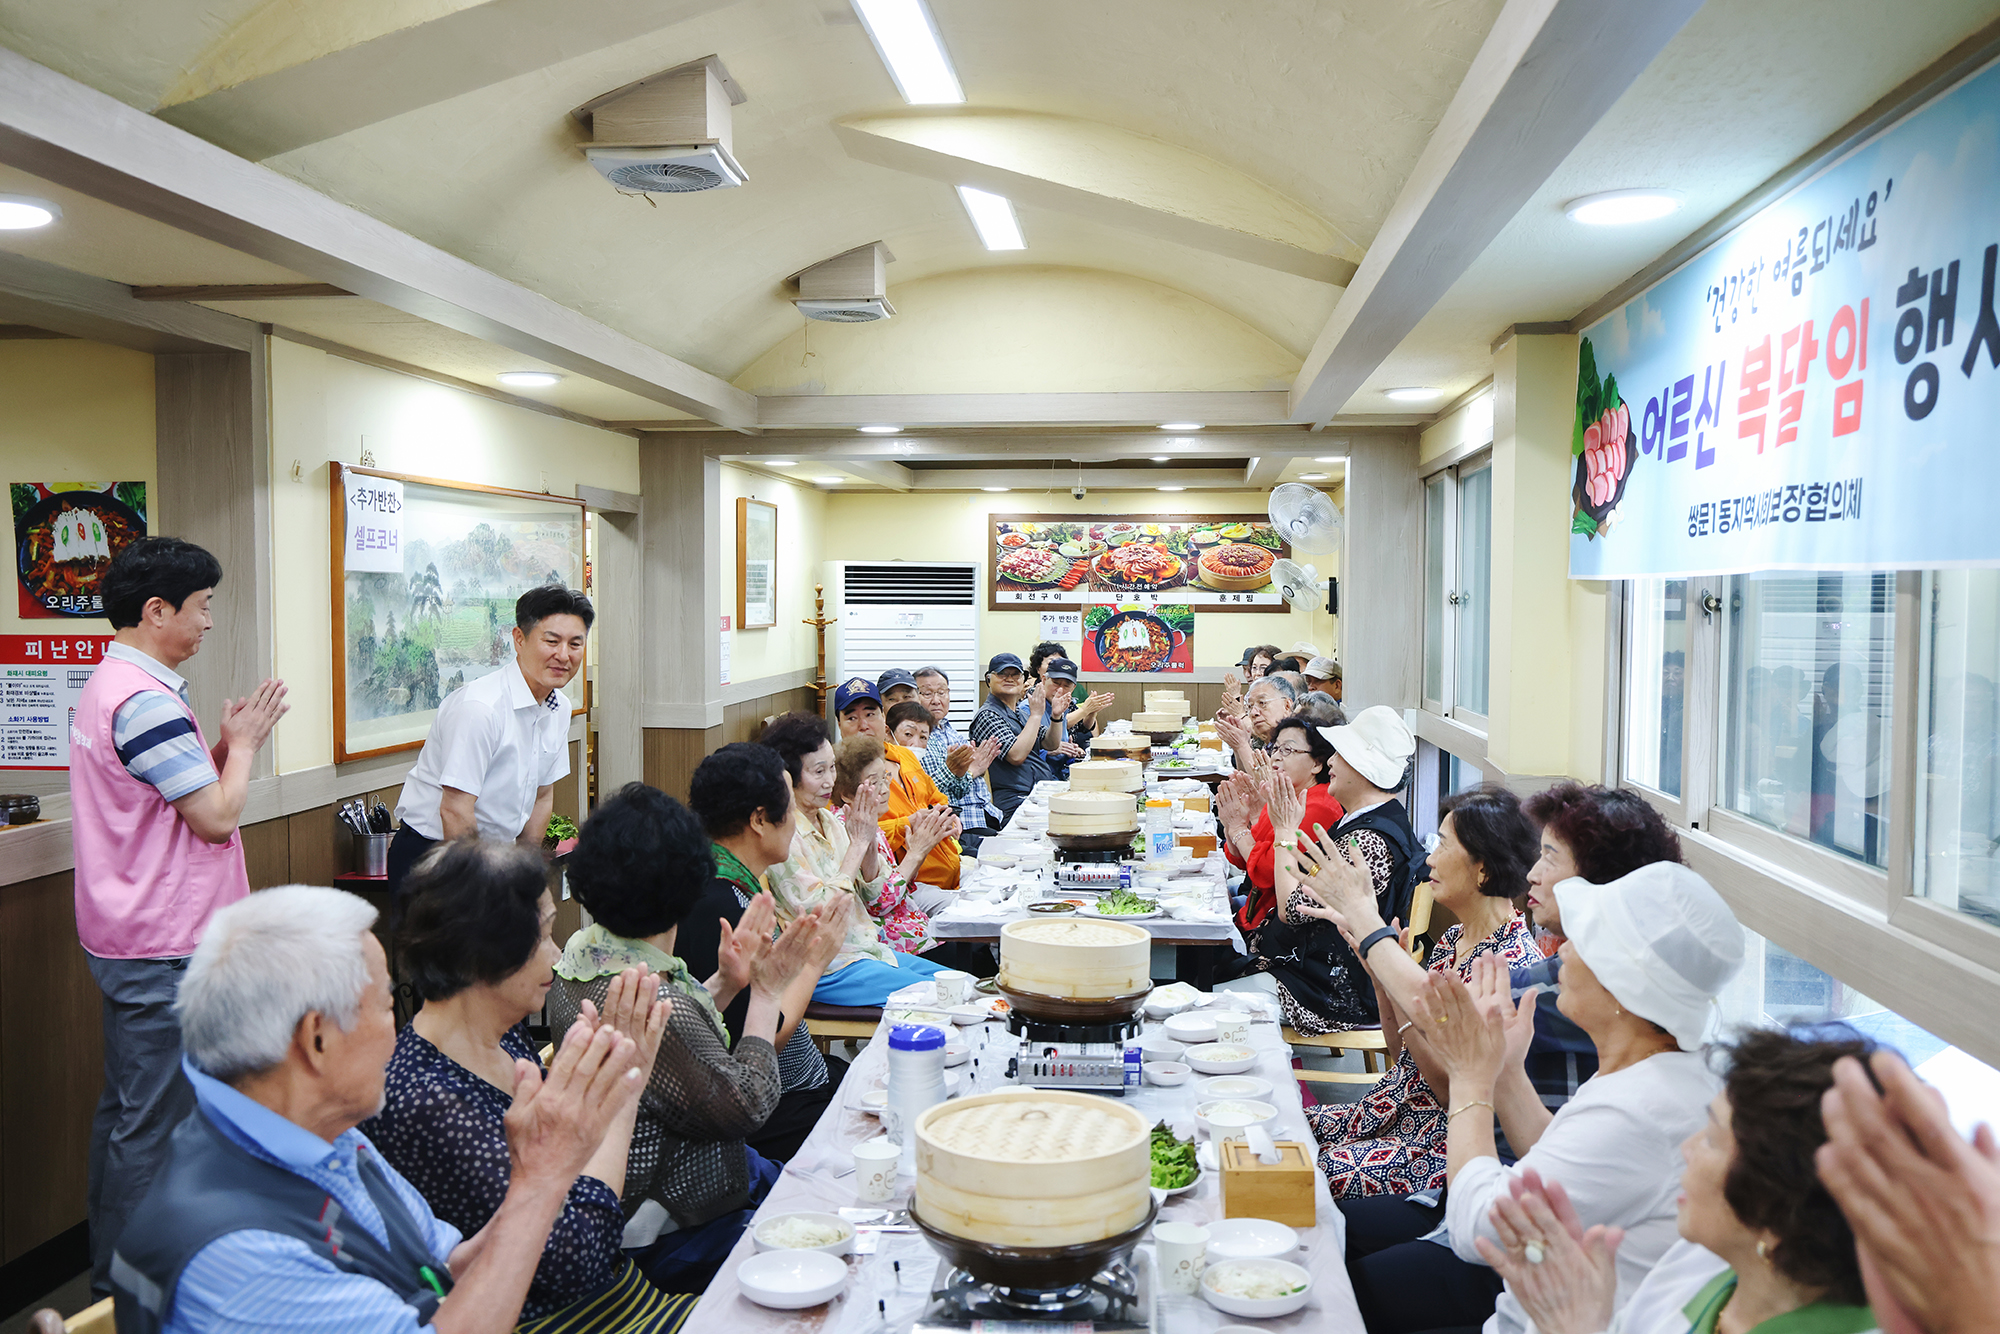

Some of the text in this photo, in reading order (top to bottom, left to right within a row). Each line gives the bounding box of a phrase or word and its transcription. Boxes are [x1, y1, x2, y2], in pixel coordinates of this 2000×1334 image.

[1641, 360, 1726, 470] 어르신
[1737, 297, 1870, 455] 복달임
[354, 525, 398, 553] 셀프코너
[46, 595, 104, 610] 오리주물
[25, 640, 107, 660] 피난안
